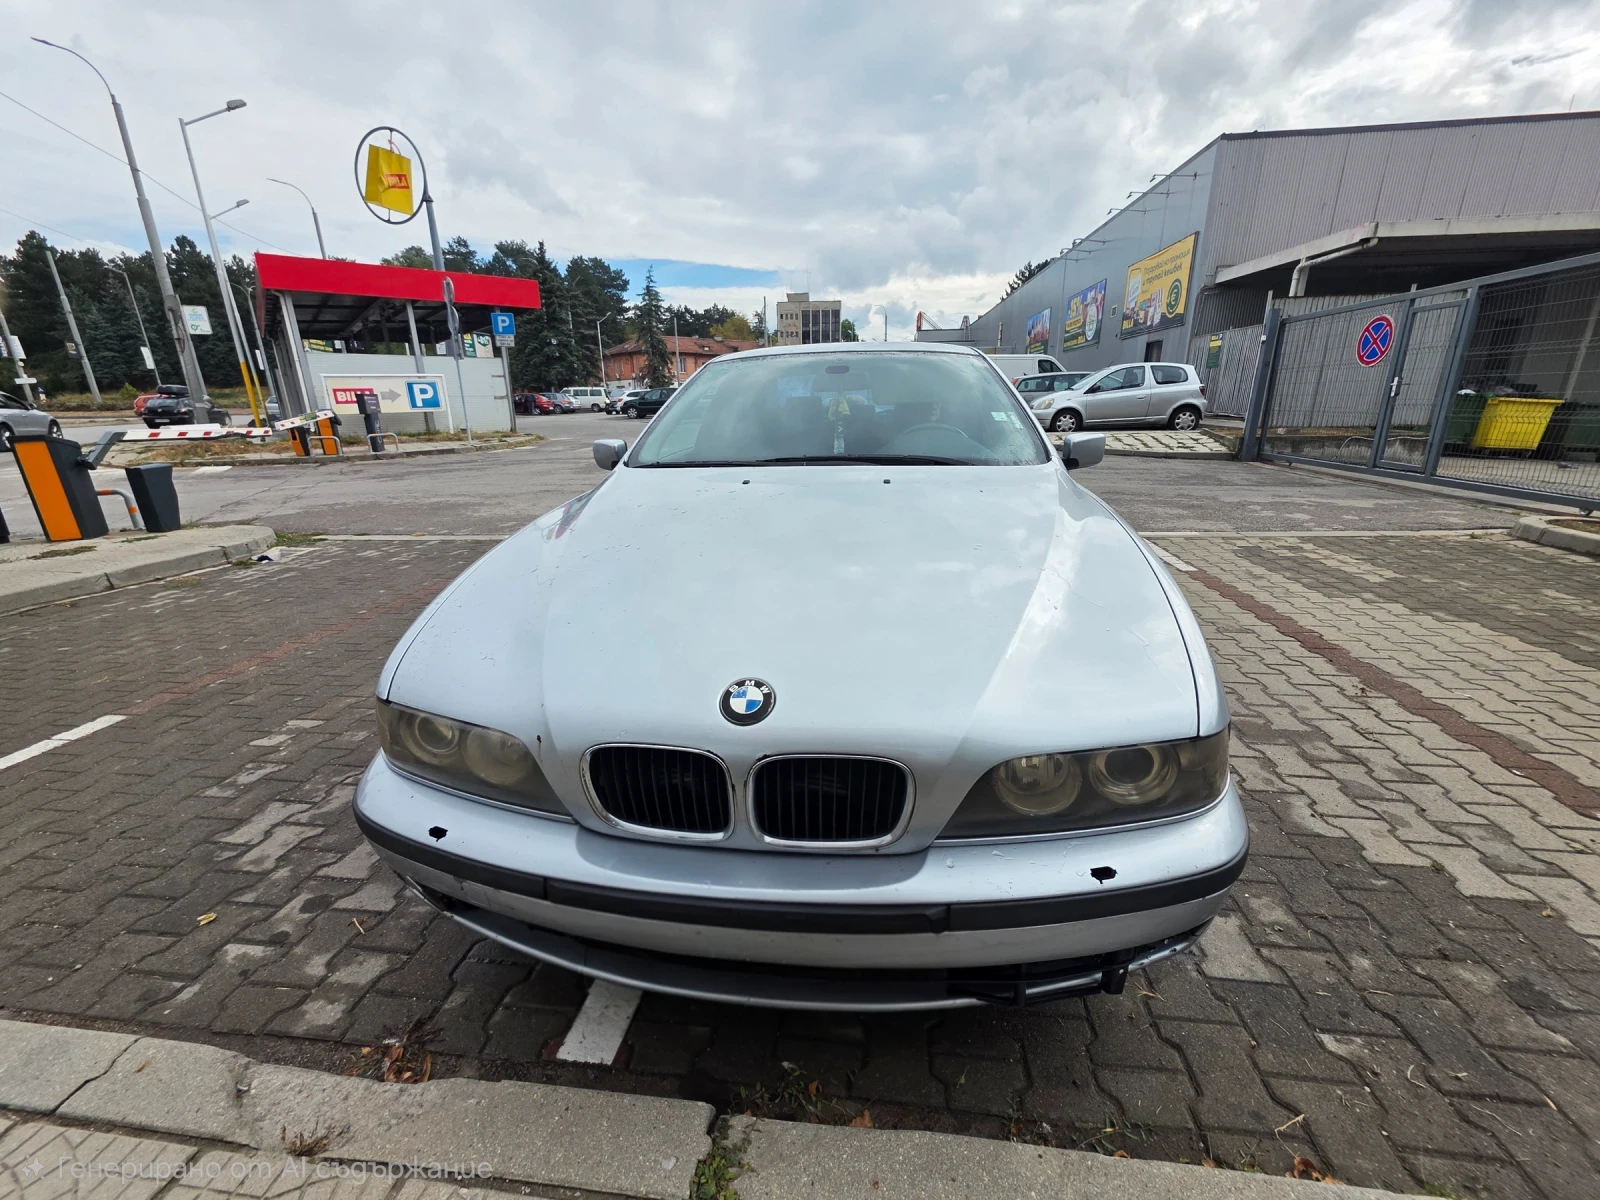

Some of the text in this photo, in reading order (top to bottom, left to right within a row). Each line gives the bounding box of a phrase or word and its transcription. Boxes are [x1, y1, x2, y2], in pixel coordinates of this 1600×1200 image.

[497, 316, 510, 333] P
[413, 383, 434, 407] P
[728, 680, 771, 694] BMW
